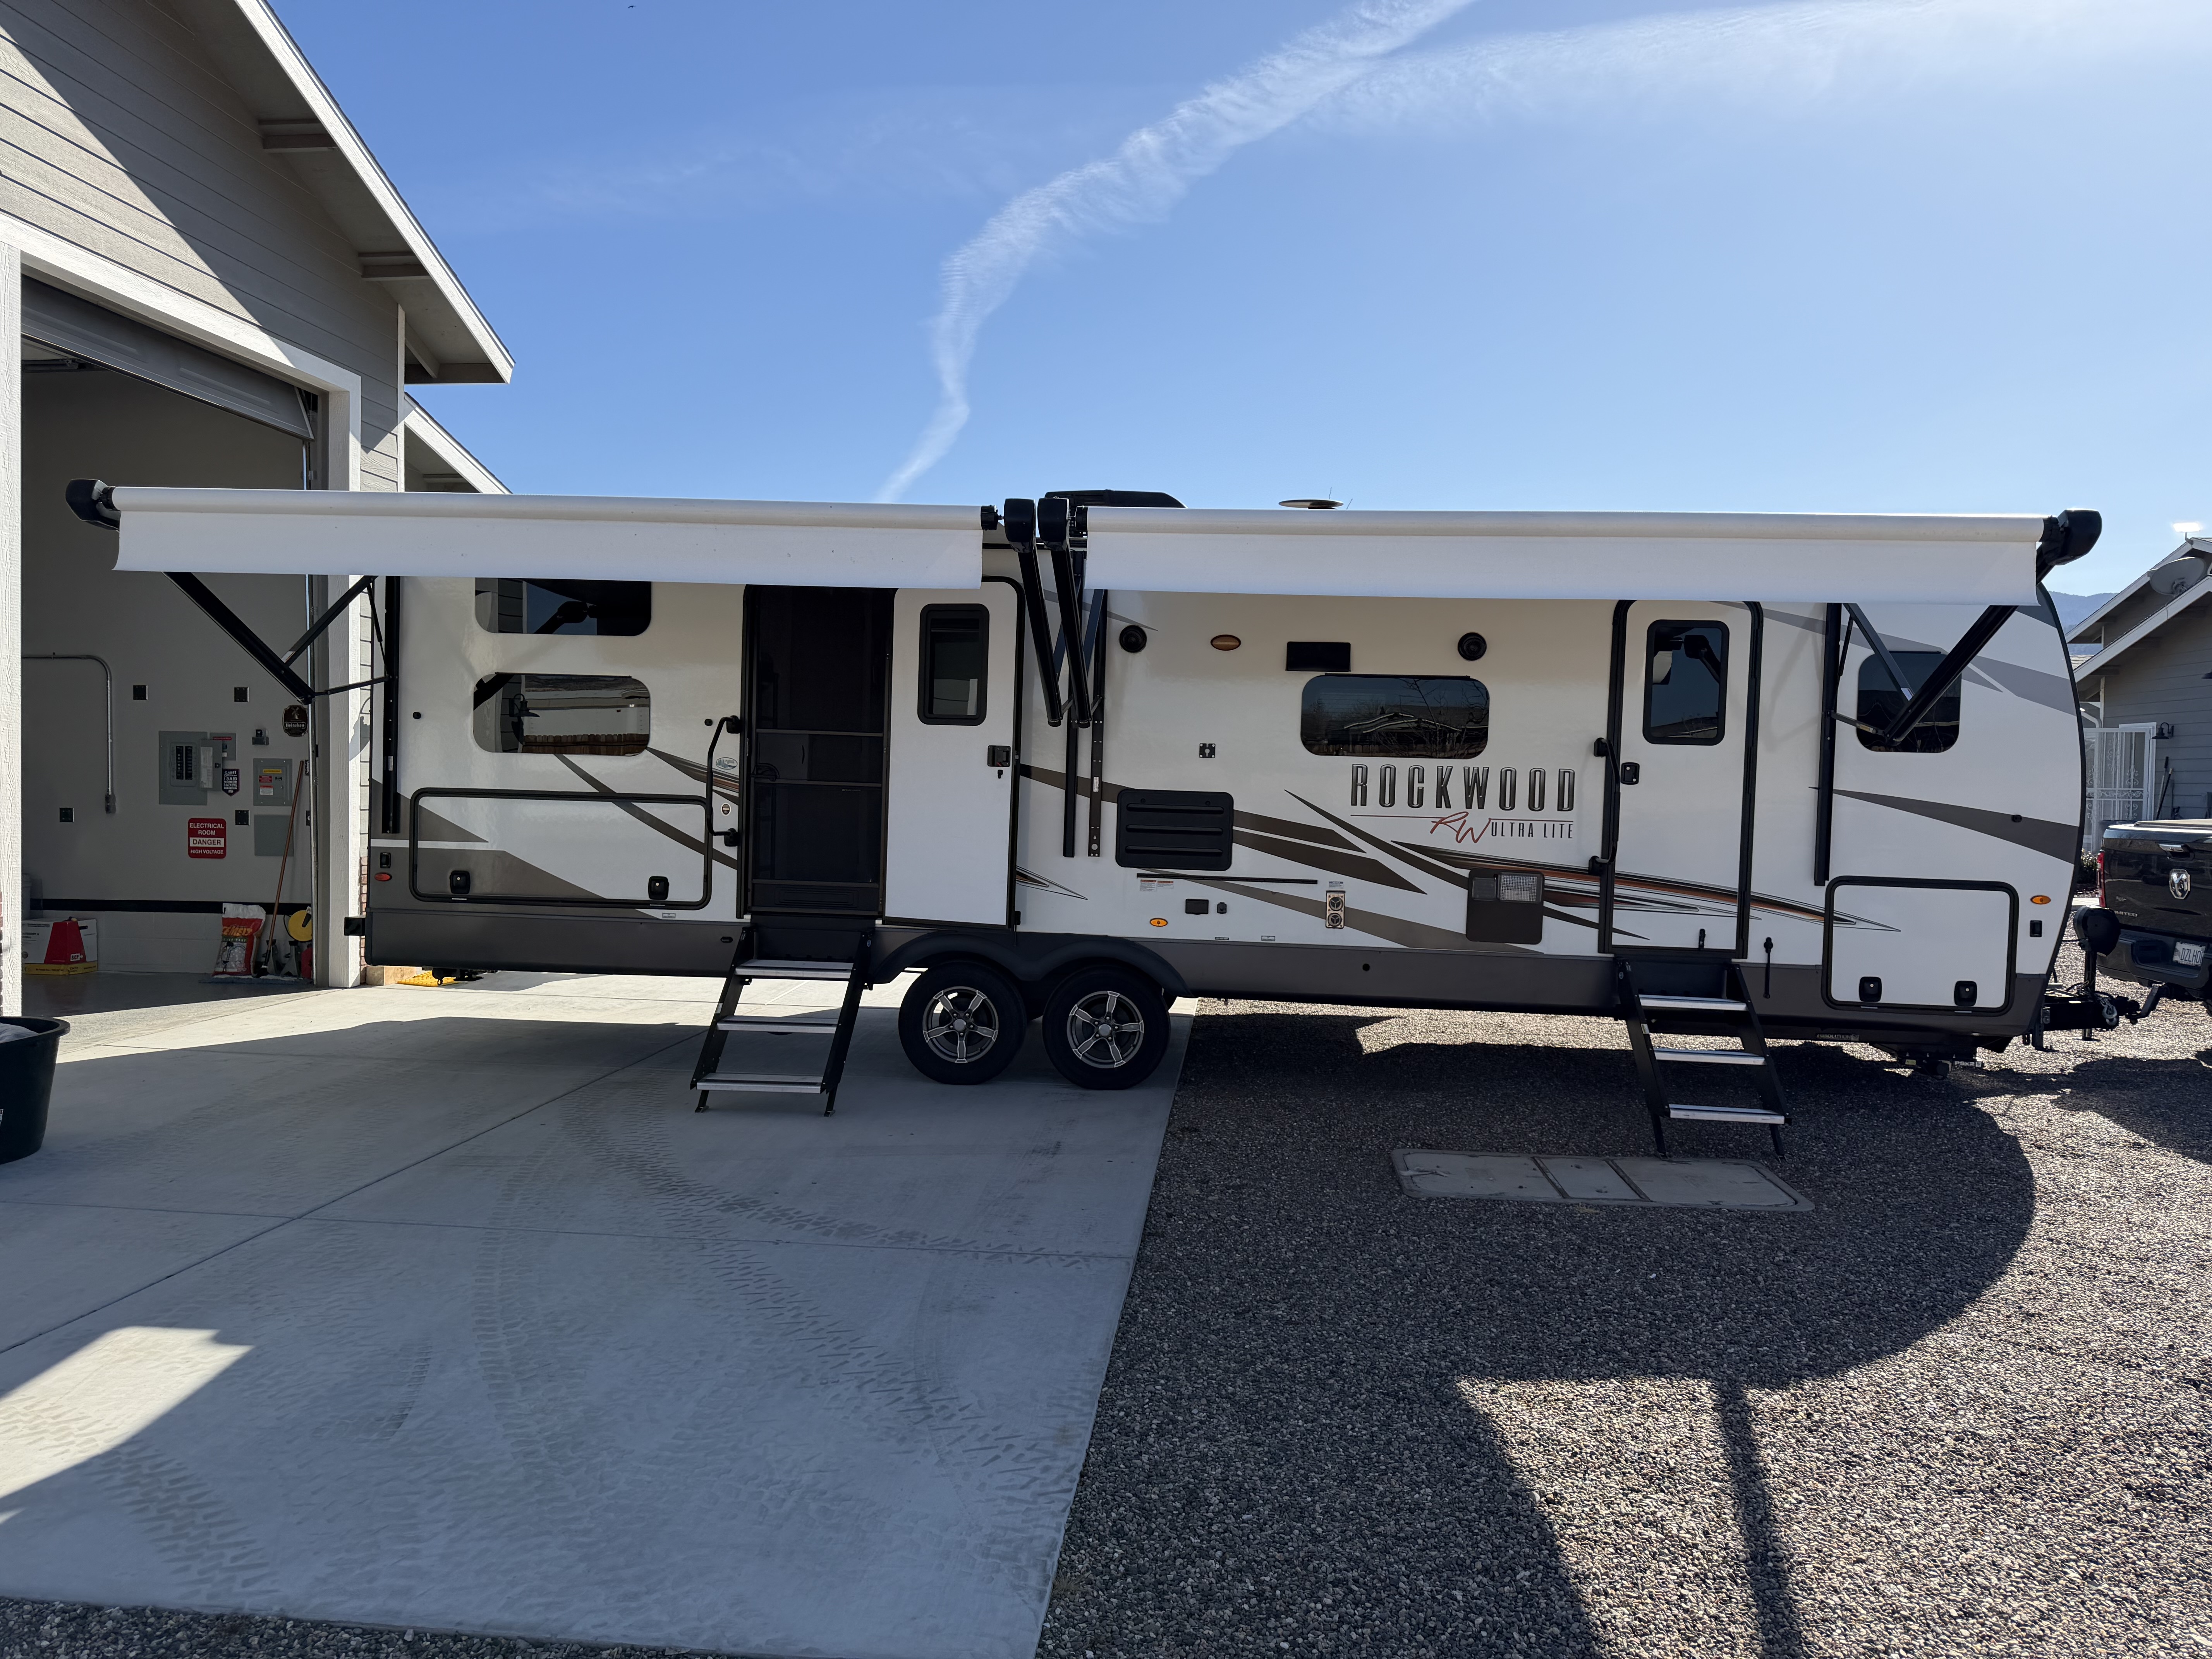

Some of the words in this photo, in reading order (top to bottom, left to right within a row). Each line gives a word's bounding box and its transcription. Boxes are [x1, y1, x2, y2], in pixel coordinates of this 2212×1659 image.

[1351, 764, 1575, 812] ROCKWOOD
[1491, 822, 1534, 838] ULTRA
[1543, 823, 1573, 838] LITE
